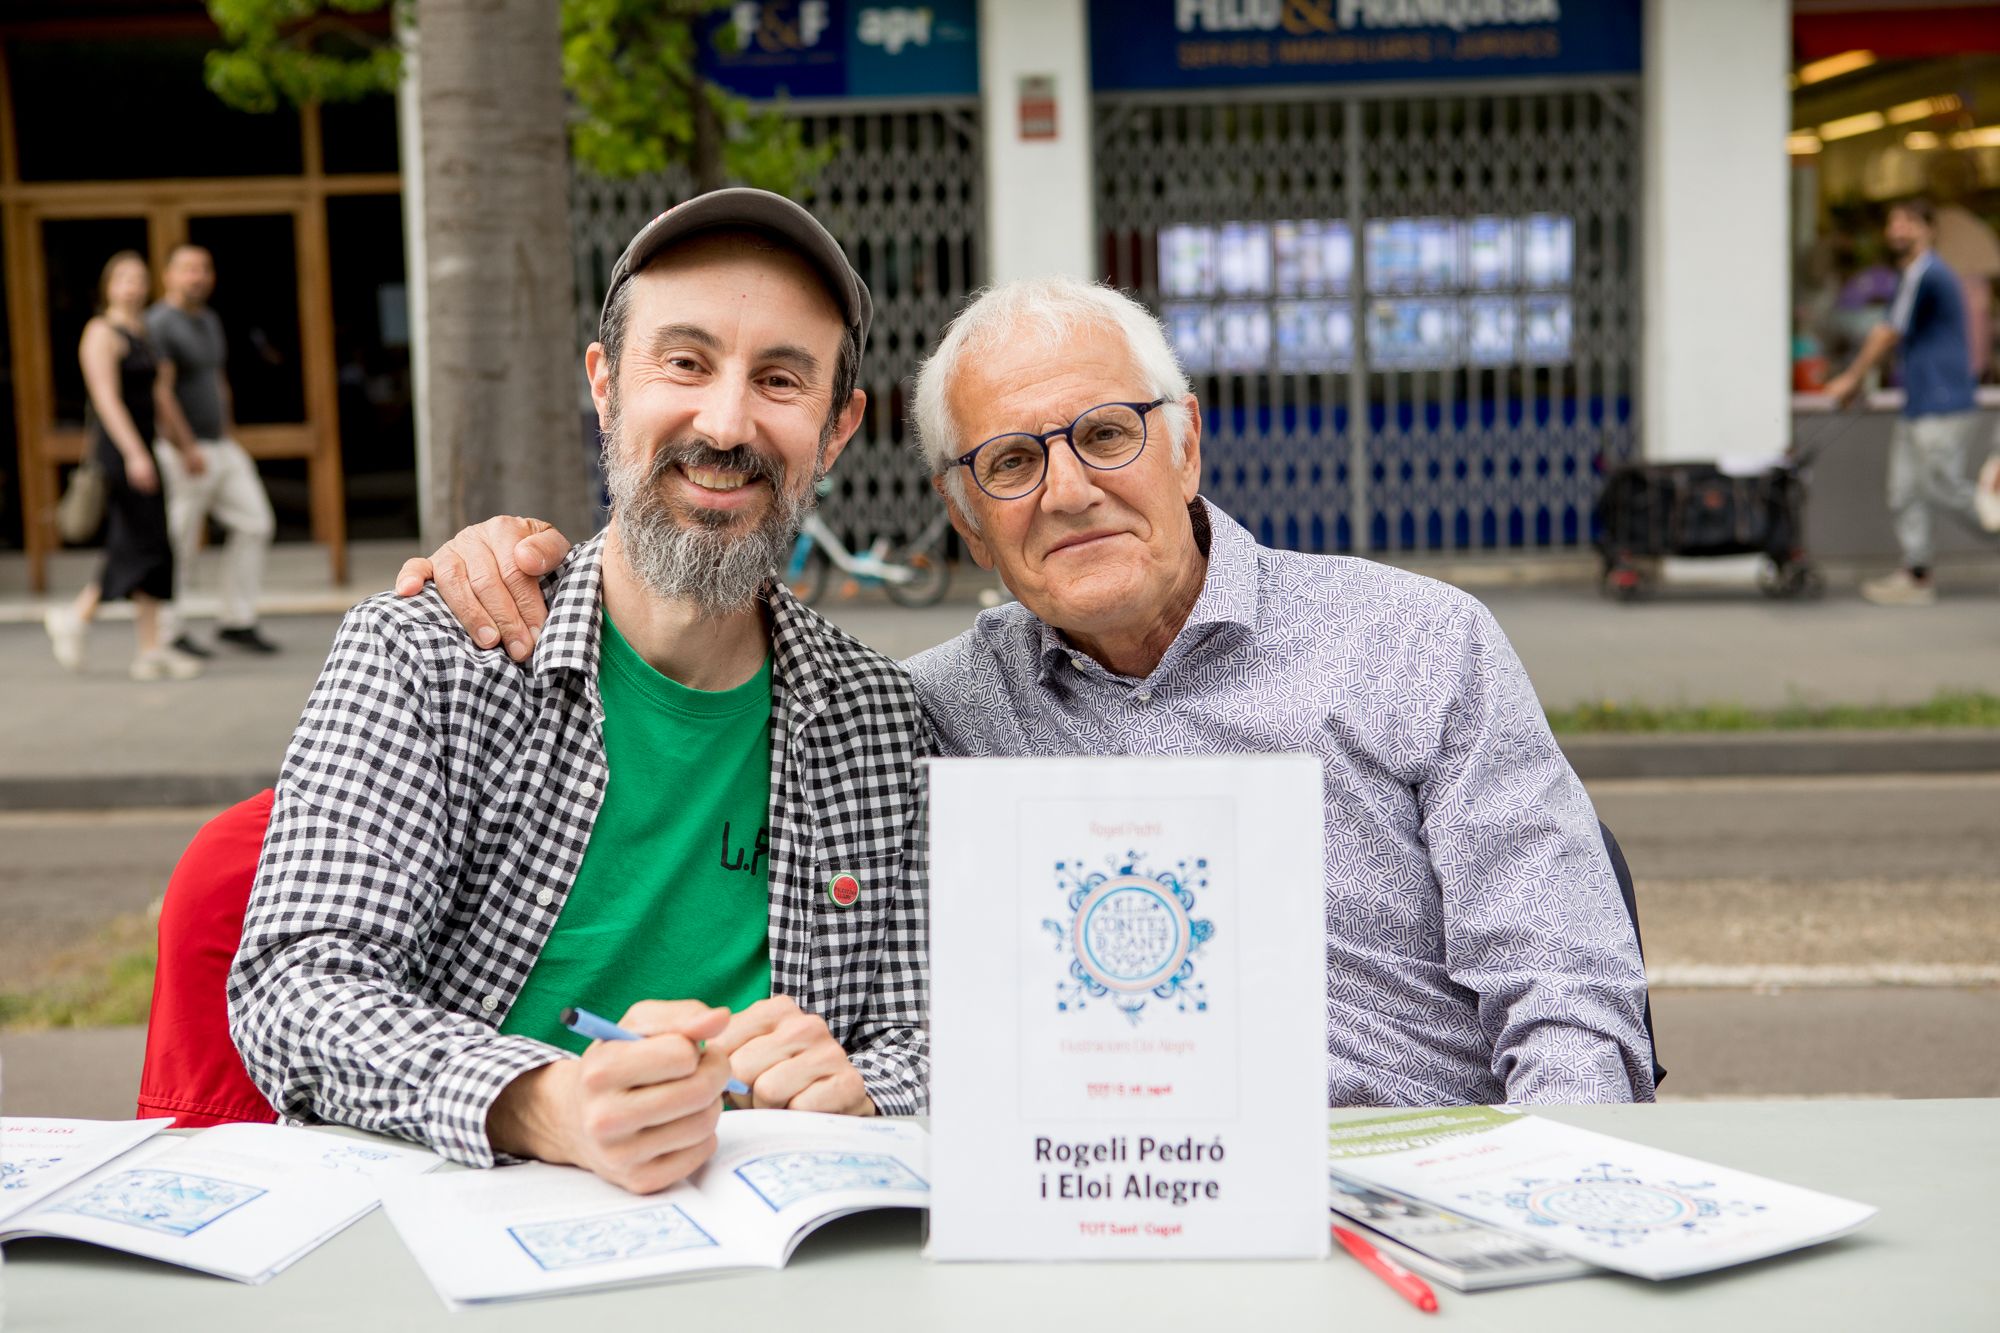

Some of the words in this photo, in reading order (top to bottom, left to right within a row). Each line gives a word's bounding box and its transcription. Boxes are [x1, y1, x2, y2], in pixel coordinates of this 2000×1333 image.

[1035, 1137, 1127, 1168] Rogeli
[1139, 1135, 1225, 1162] Pedró
[1041, 1174, 1047, 1199] i
[1059, 1174, 1111, 1199] Eloi
[1124, 1174, 1219, 1206] Alegre
